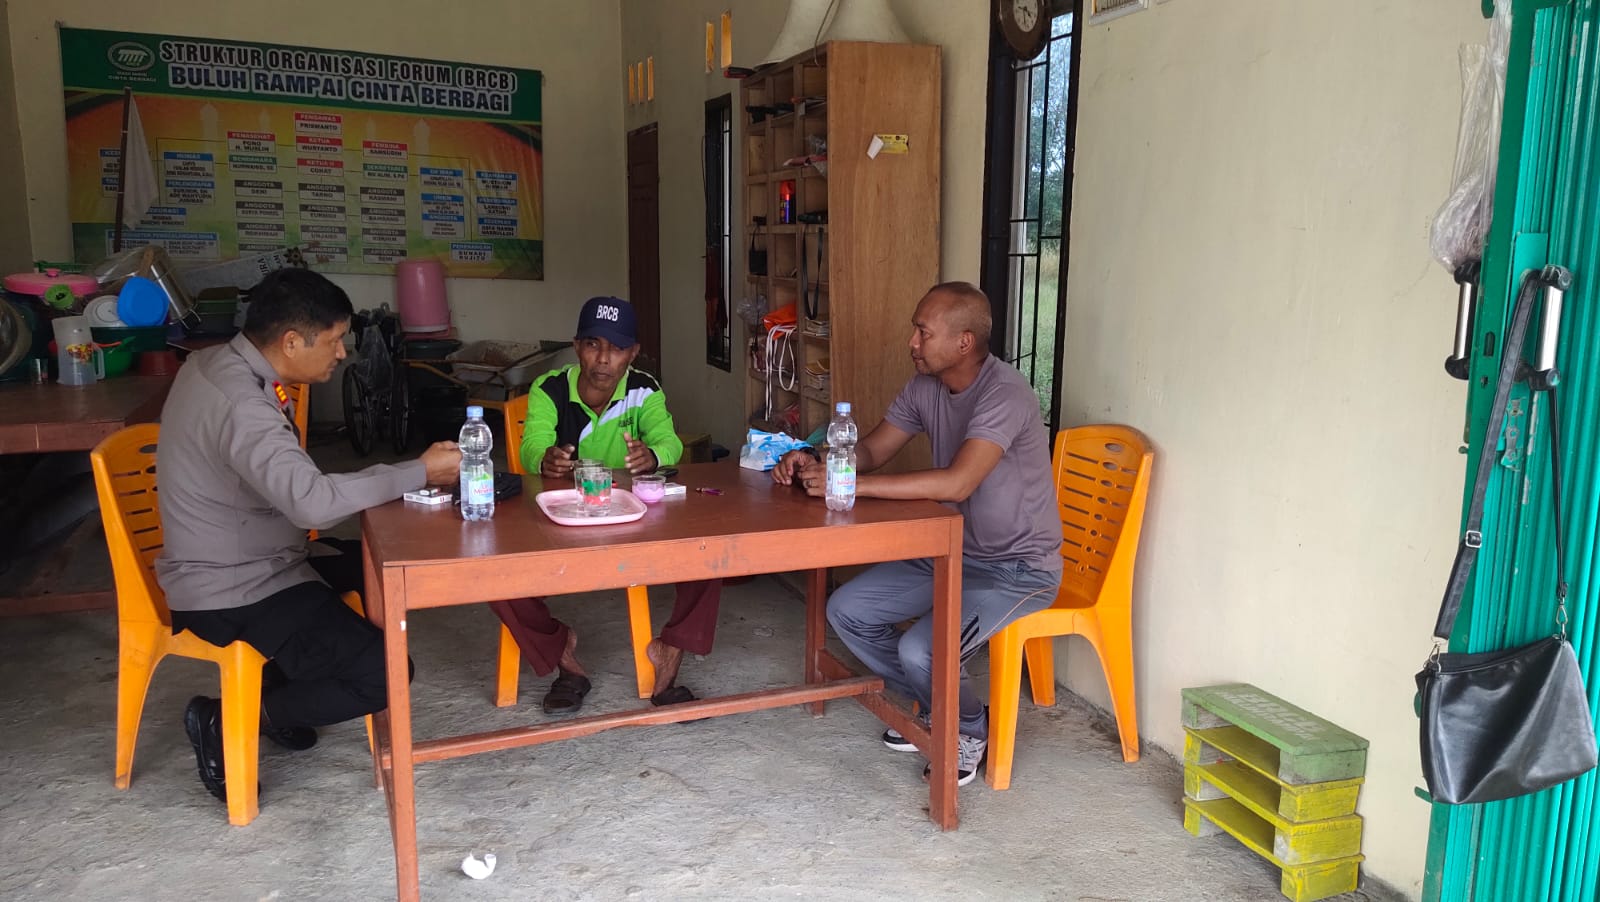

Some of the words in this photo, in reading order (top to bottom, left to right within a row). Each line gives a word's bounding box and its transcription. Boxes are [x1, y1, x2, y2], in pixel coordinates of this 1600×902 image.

[161, 41, 263, 68] STRUKTUR
[267, 50, 385, 79] ORGANISASI
[389, 60, 452, 86] FORUM
[457, 67, 517, 94] (BRCB)
[169, 63, 249, 92] BULUH
[253, 72, 347, 101] RAMPAI
[349, 79, 418, 106] CINTA
[420, 84, 512, 114] BERBAGI
[596, 304, 619, 321] BRCB
